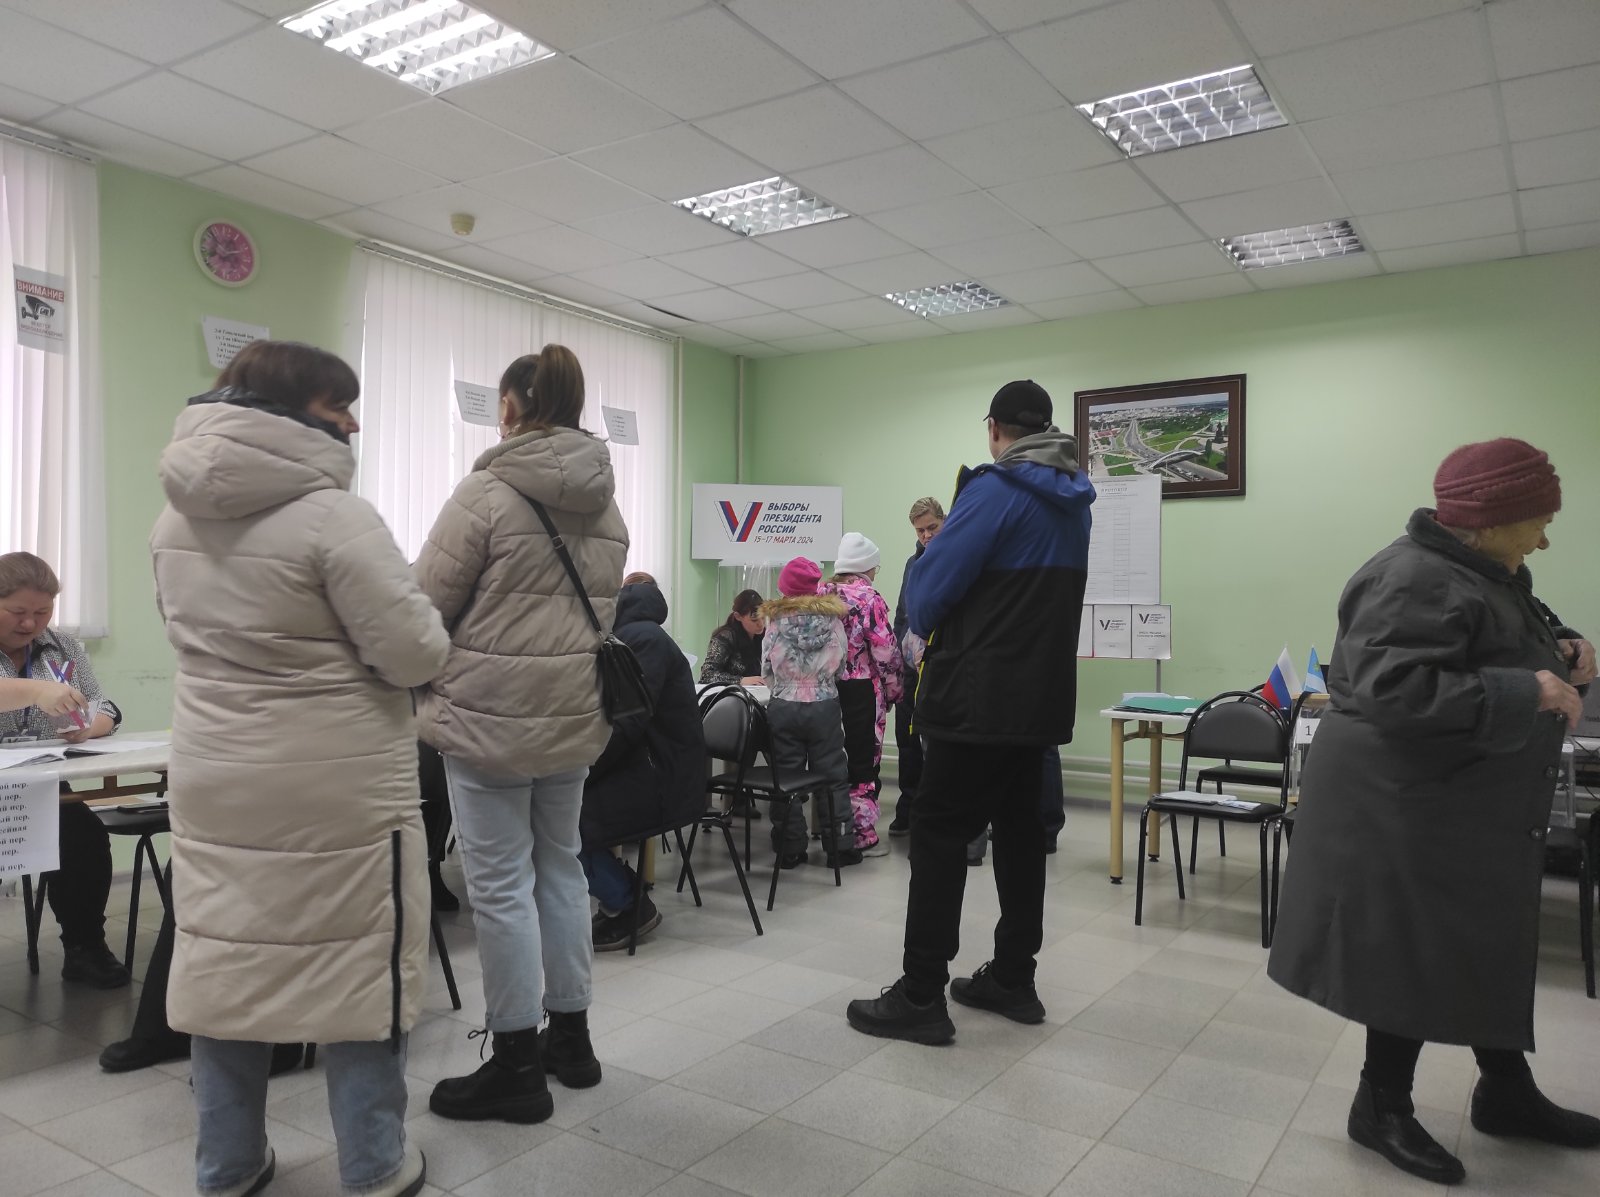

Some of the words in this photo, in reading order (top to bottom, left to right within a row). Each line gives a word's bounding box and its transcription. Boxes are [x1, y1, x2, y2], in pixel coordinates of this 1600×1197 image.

[17, 281, 64, 301] ВНИМАНИЕ
[767, 502, 810, 512] ВЫБОРЫ
[762, 513, 822, 524] ПРЕЗИДЕНТА
[757, 524, 796, 534] РОССИИ
[773, 536, 796, 544] МАРТА
[796, 536, 814, 544] 2024
[1305, 725, 1312, 736] 1
